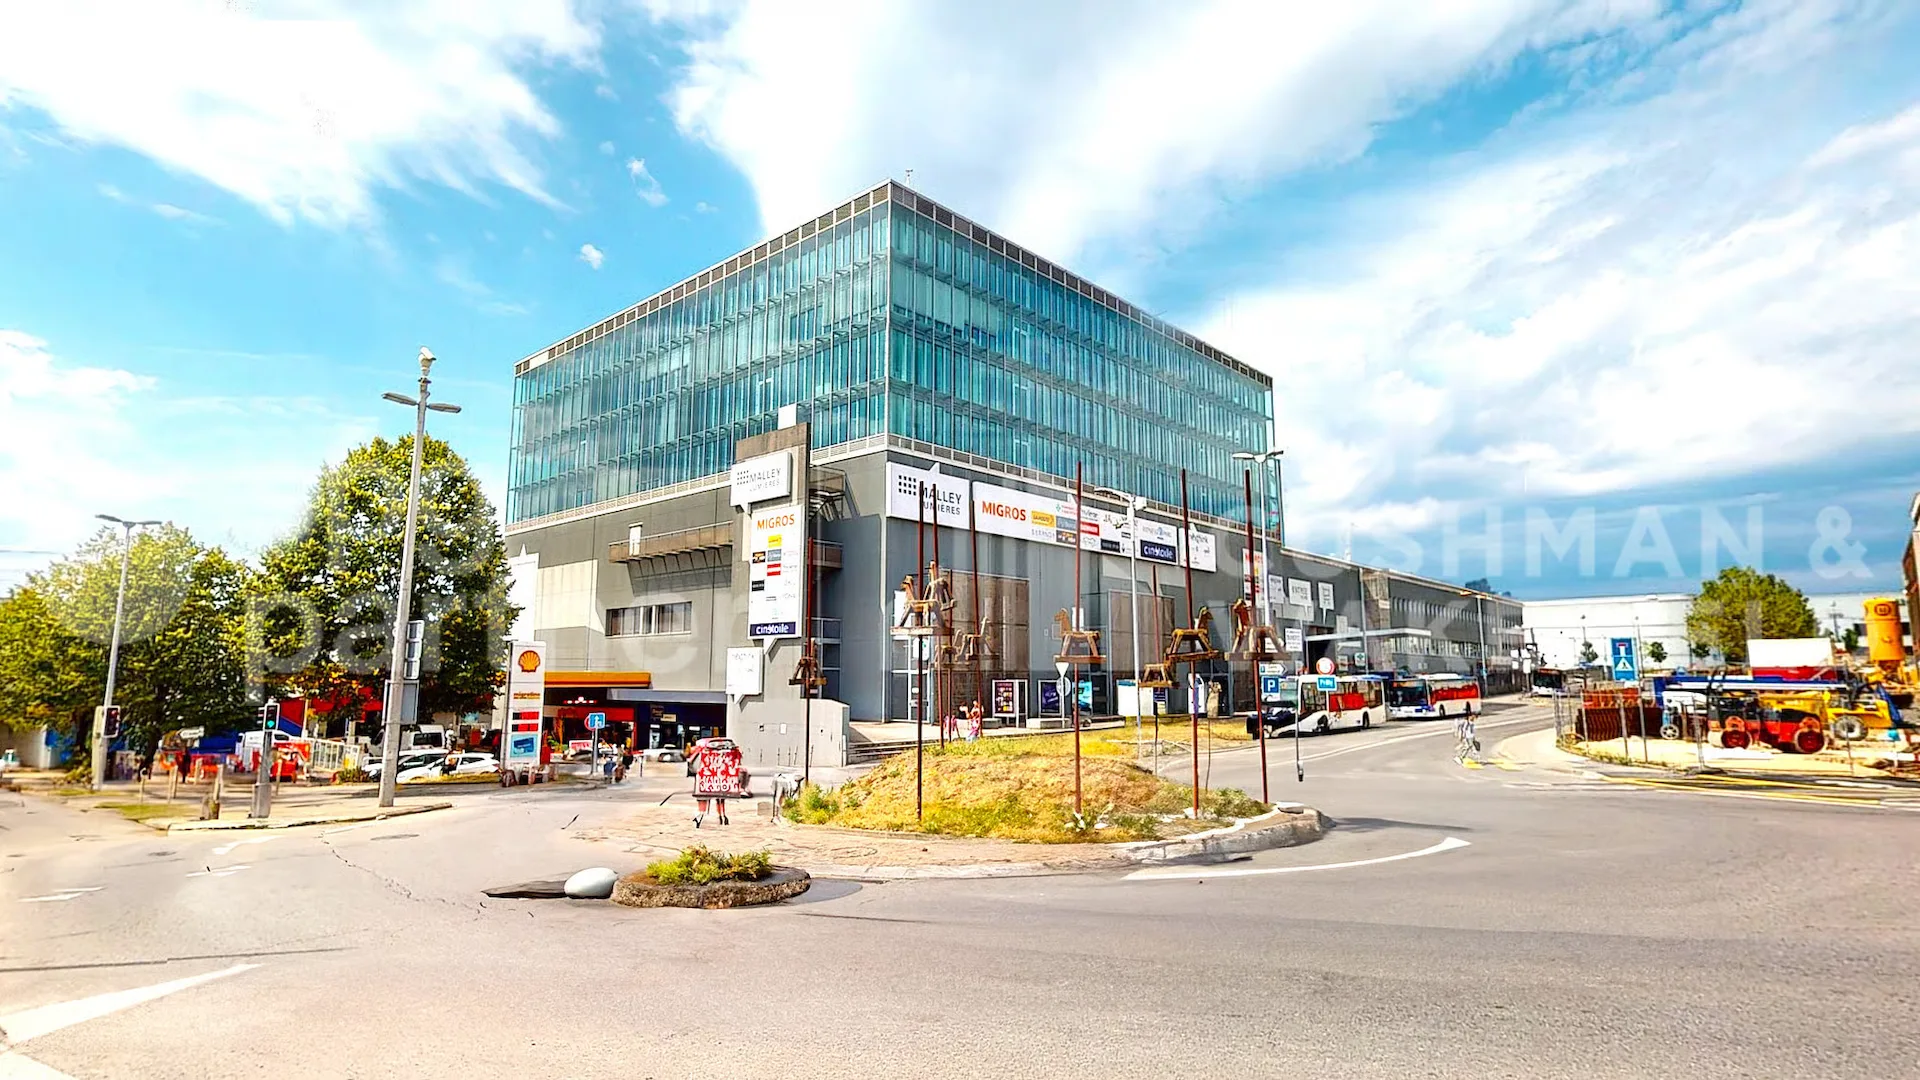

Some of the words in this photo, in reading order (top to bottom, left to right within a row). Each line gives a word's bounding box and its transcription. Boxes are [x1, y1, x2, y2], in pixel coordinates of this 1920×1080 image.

[749, 467, 781, 484] MALLEY
[982, 501, 1027, 521] MIGROS
[757, 513, 795, 531] MIGROS
[1267, 679, 1276, 692] P
